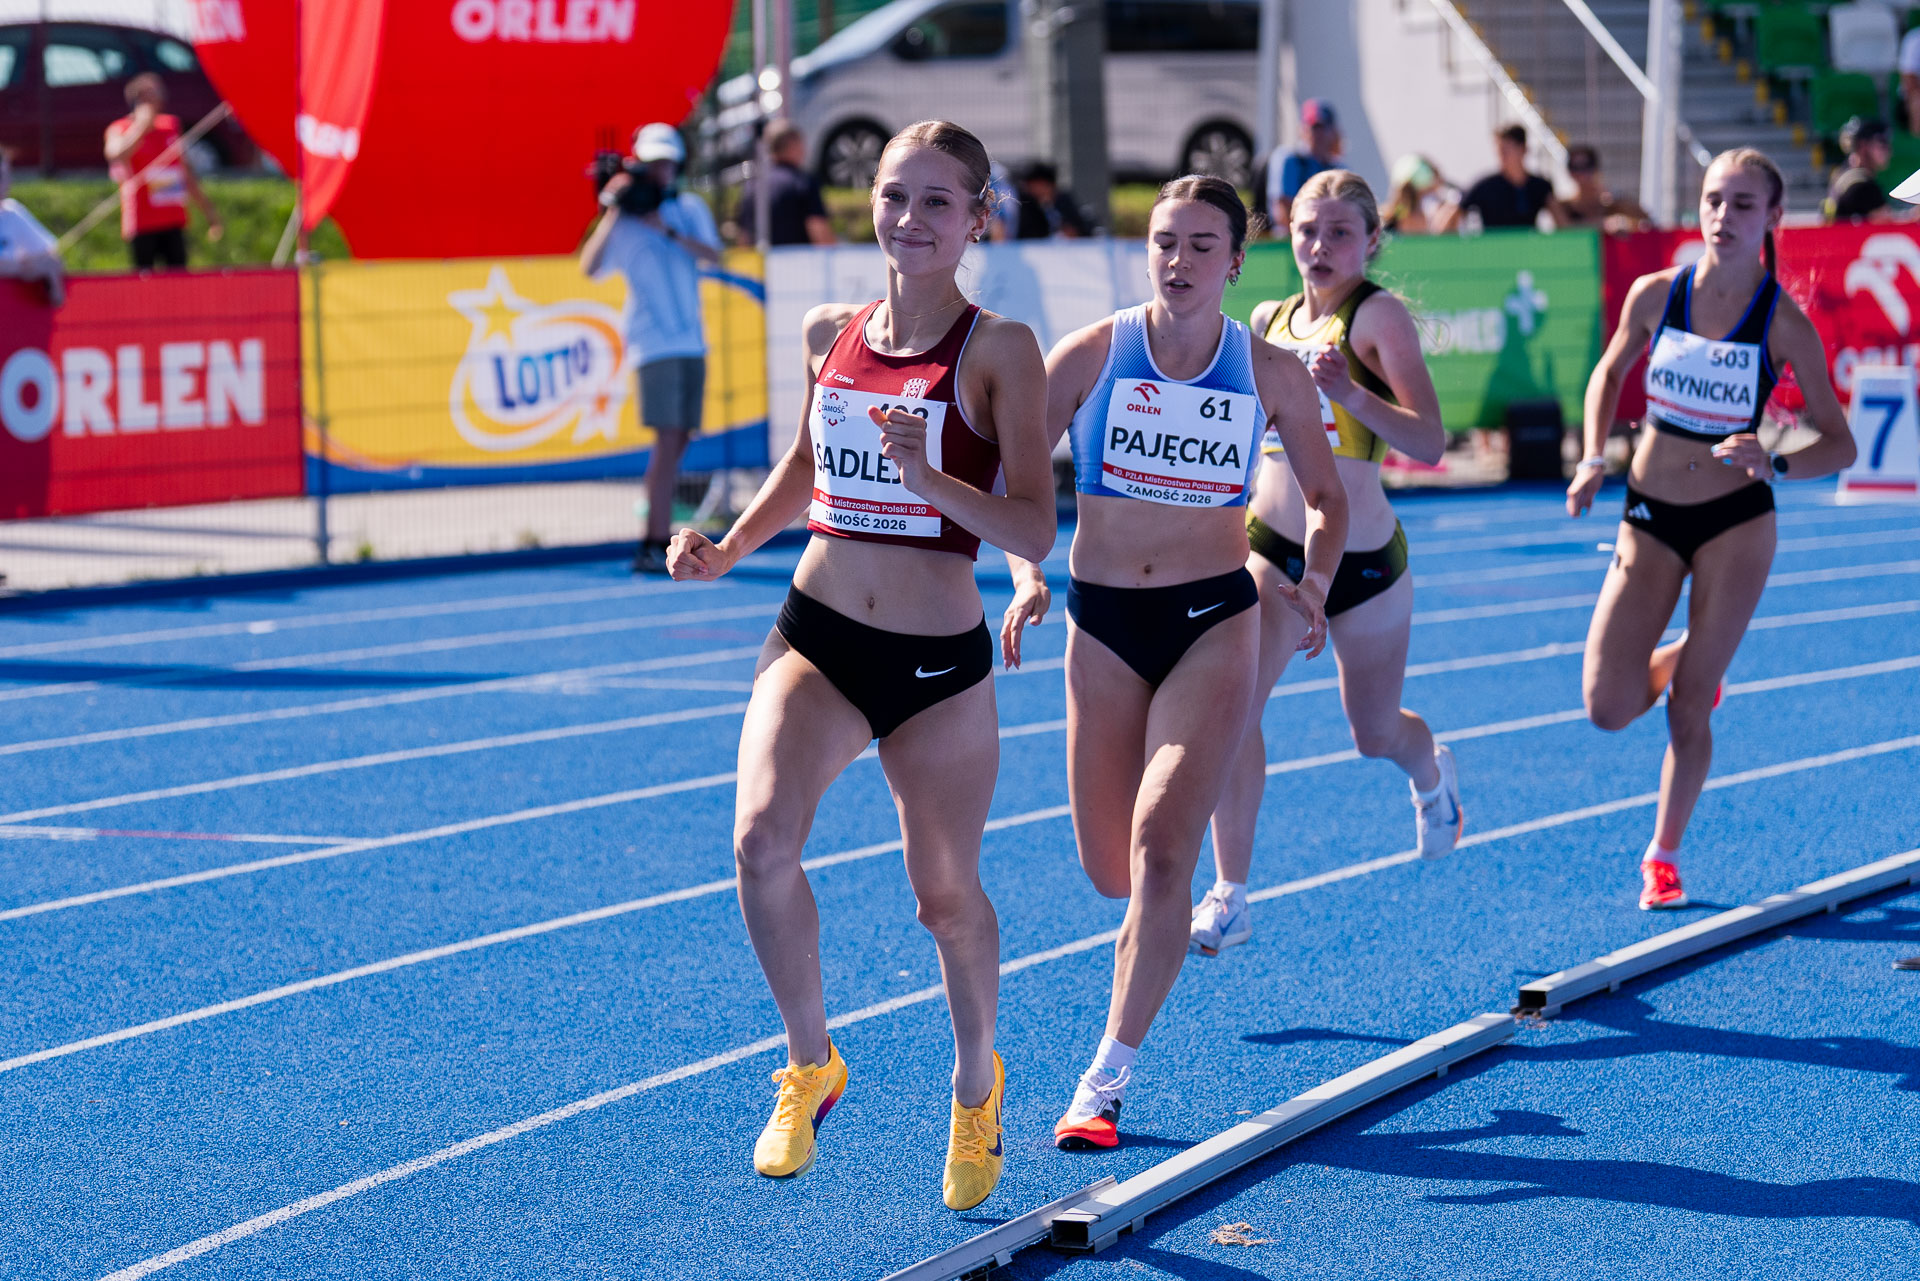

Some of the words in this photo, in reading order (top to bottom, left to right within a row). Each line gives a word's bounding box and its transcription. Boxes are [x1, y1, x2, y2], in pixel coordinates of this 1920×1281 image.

[450, 0, 638, 43] ORLEN
[1710, 348, 1750, 370] 503
[492, 337, 591, 410] LOTTO
[0, 338, 265, 443] ORLEN
[1650, 367, 1751, 407] KRYNICKA
[1126, 403, 1162, 416] ORLEN
[1200, 396, 1232, 422] 61
[1862, 396, 1905, 469] 7
[1110, 426, 1241, 469] PAJĘCKA
[1125, 472, 1143, 481] PZLA
[1144, 474, 1191, 488] Mistrzostwa
[1192, 482, 1214, 491] Polski
[1215, 484, 1231, 492] U20
[1126, 483, 1180, 501] ZAMOŚĆ
[1181, 493, 1212, 504] 2026
[834, 498, 880, 512] Mistrzostwa
[881, 504, 908, 514] Polski
[909, 506, 927, 515] U20
[825, 510, 870, 527] ZAMOŚĆ
[873, 518, 907, 530] 2026
